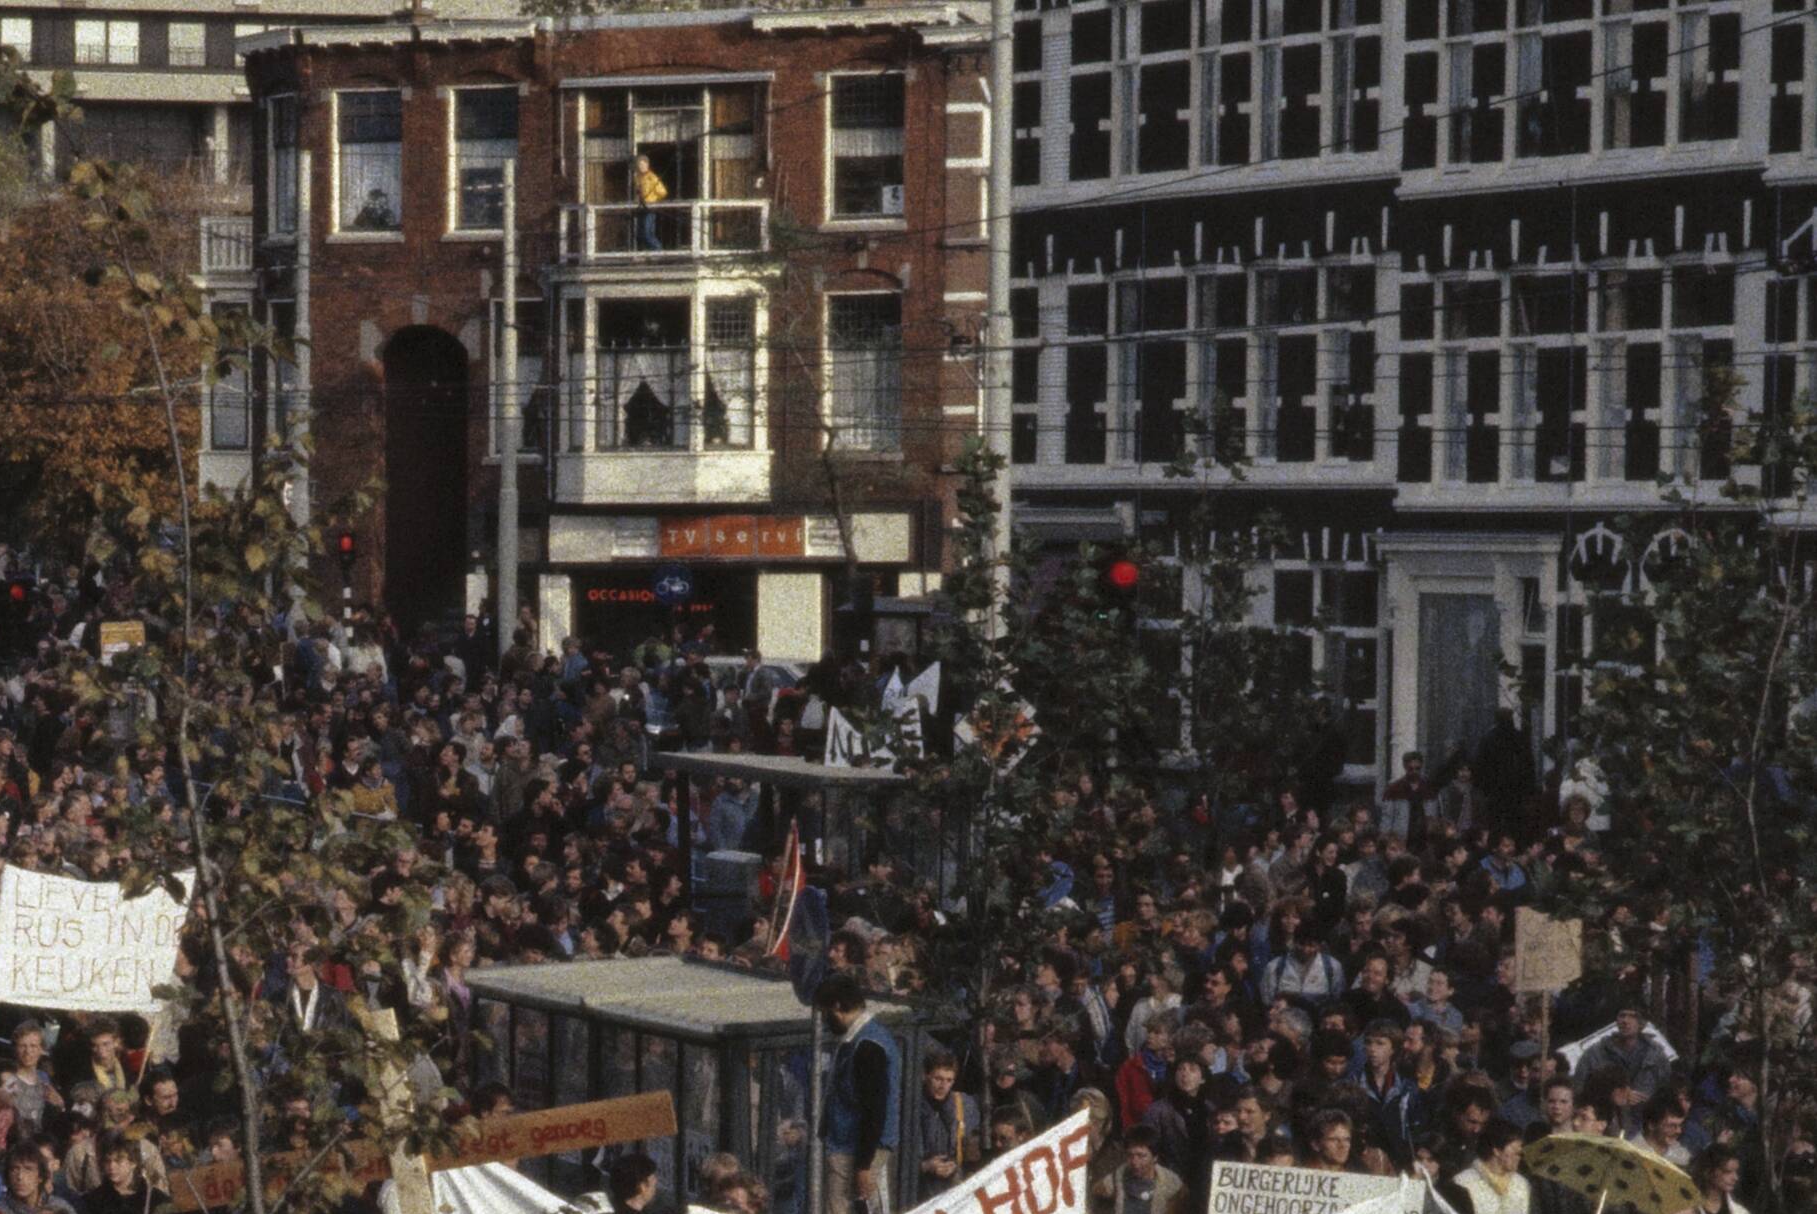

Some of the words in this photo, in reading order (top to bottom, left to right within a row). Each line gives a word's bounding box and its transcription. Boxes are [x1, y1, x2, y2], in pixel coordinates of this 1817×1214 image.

[668, 528, 697, 545] TV
[14, 914, 84, 948] RUS
[105, 912, 145, 946] IN
[12, 953, 154, 995] KEUKEN
[529, 1116, 608, 1152] genoeg
